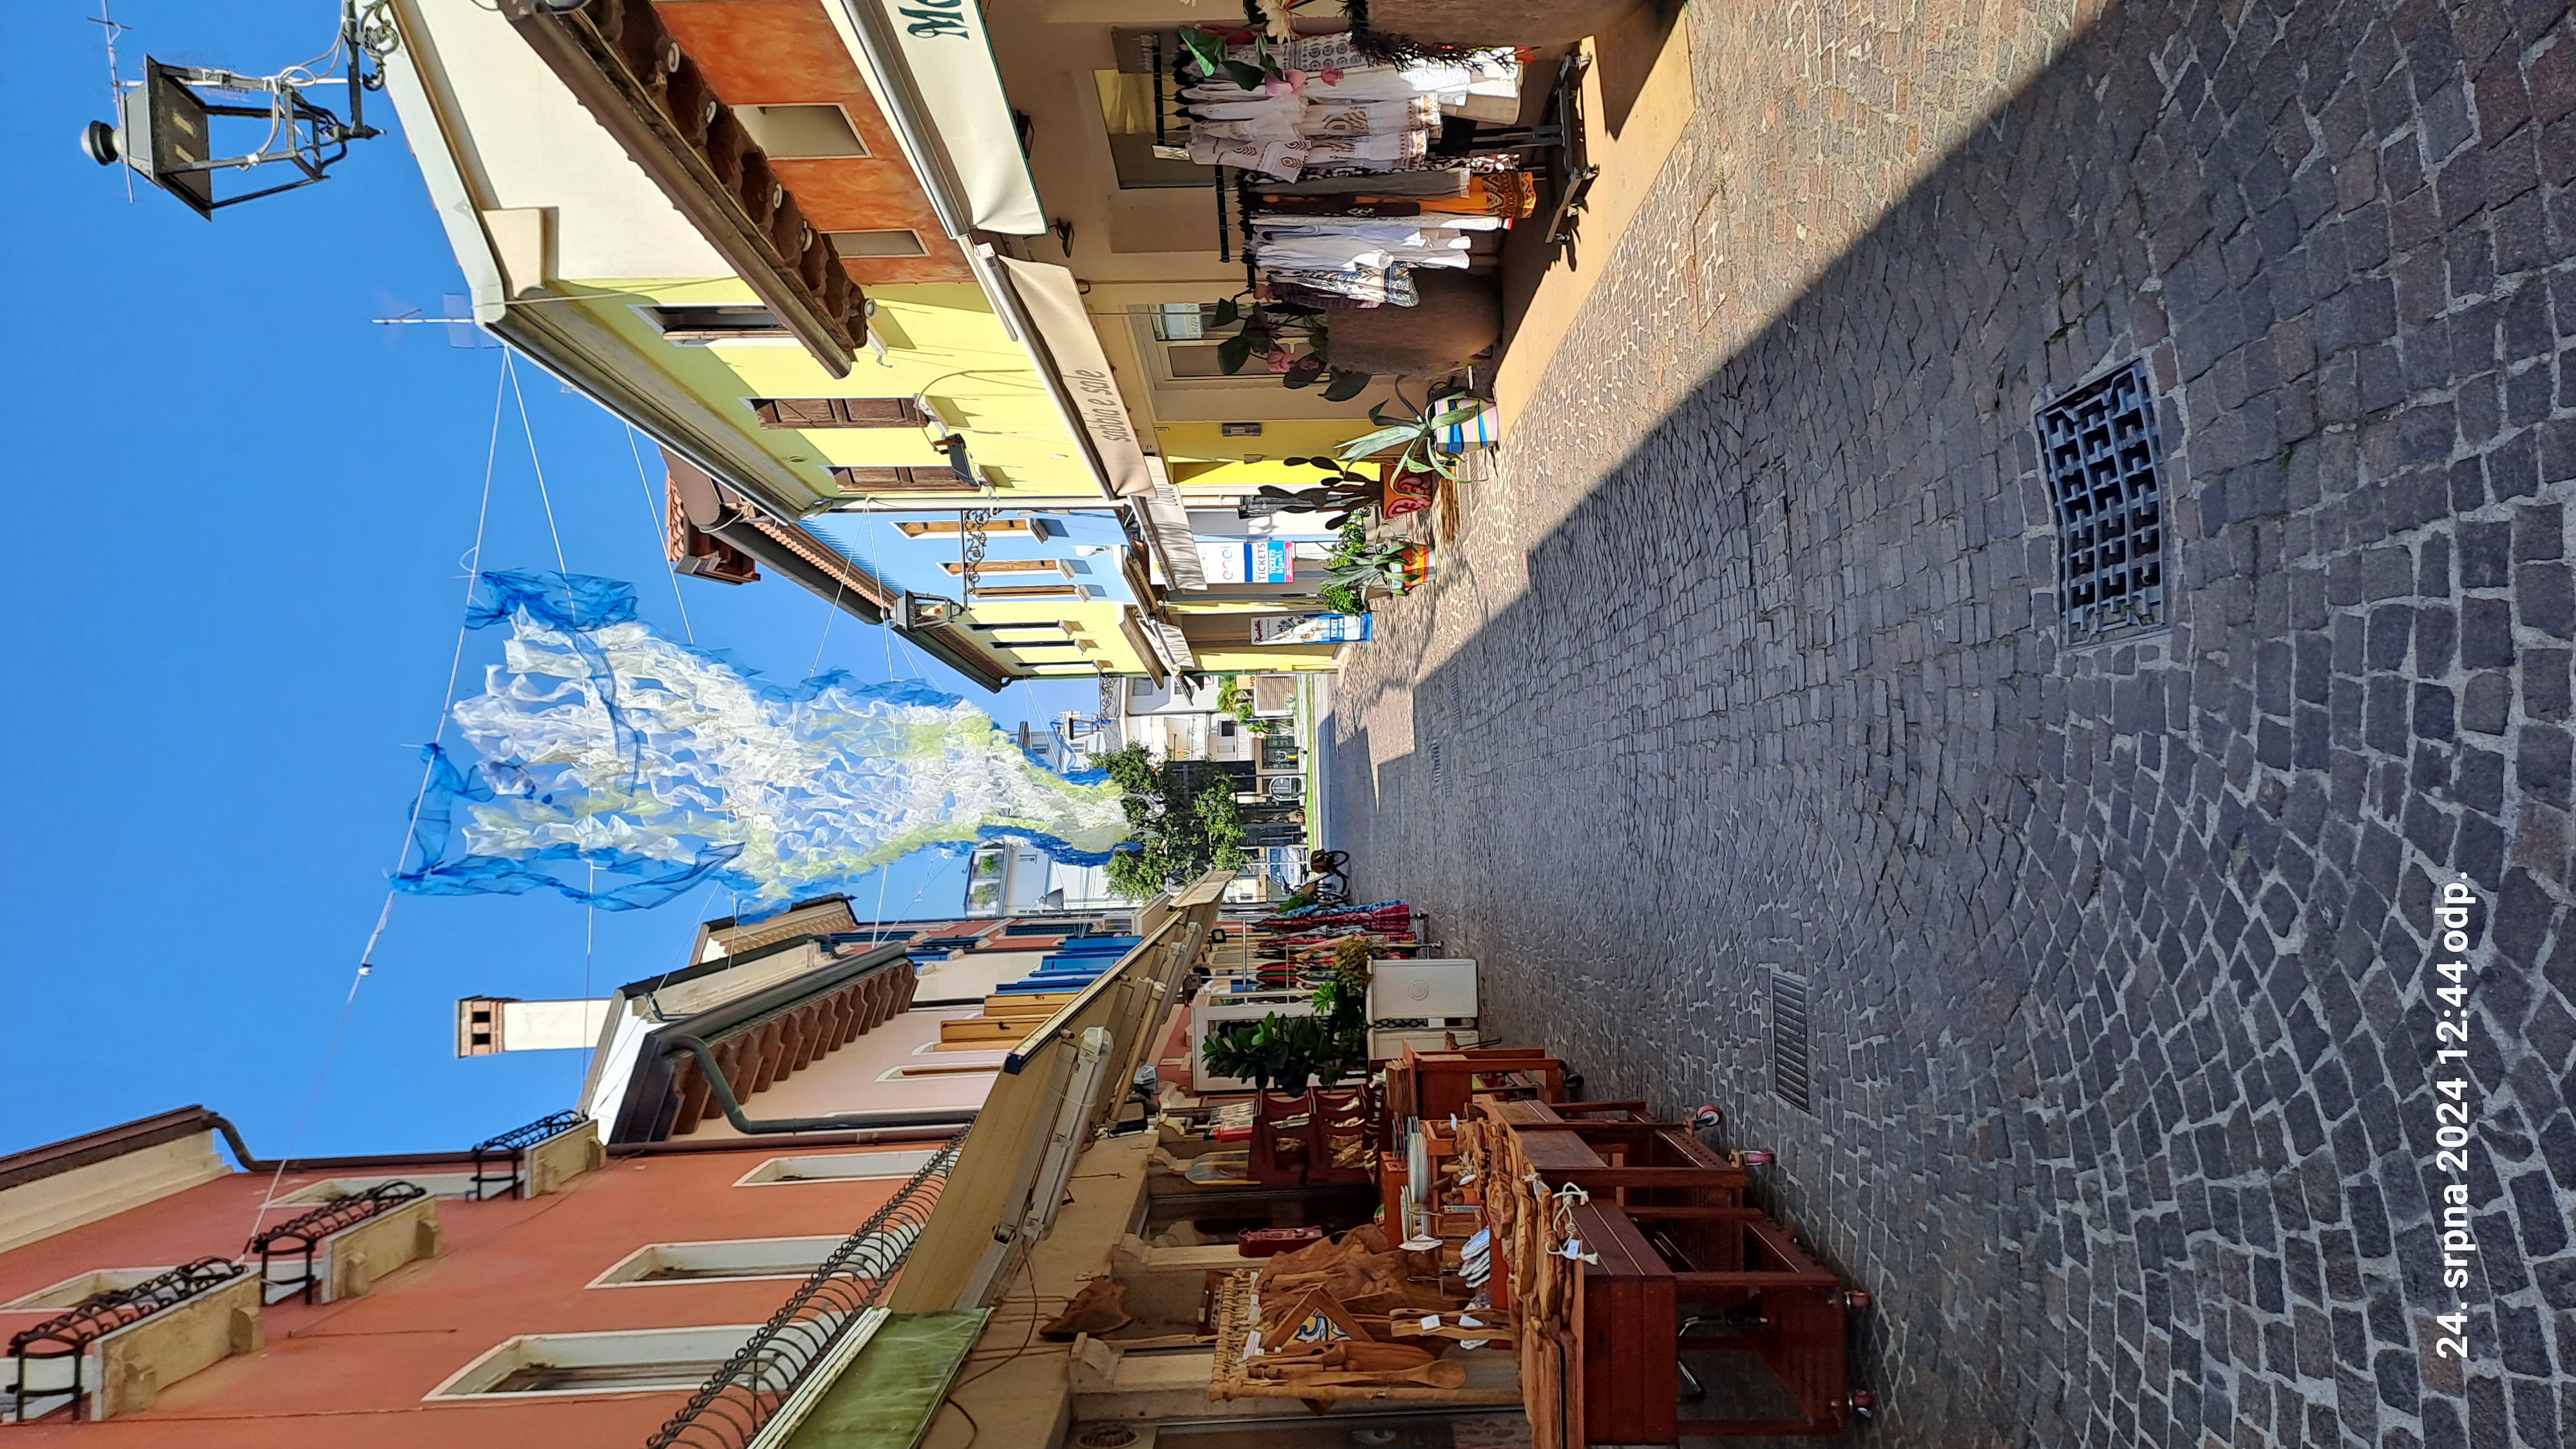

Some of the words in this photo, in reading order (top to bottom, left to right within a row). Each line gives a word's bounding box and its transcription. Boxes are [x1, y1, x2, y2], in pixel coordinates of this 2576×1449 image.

[1083, 408, 1131, 442] sabbia
[1218, 546, 1233, 580] enel
[1257, 544, 1266, 581] TICKETS
